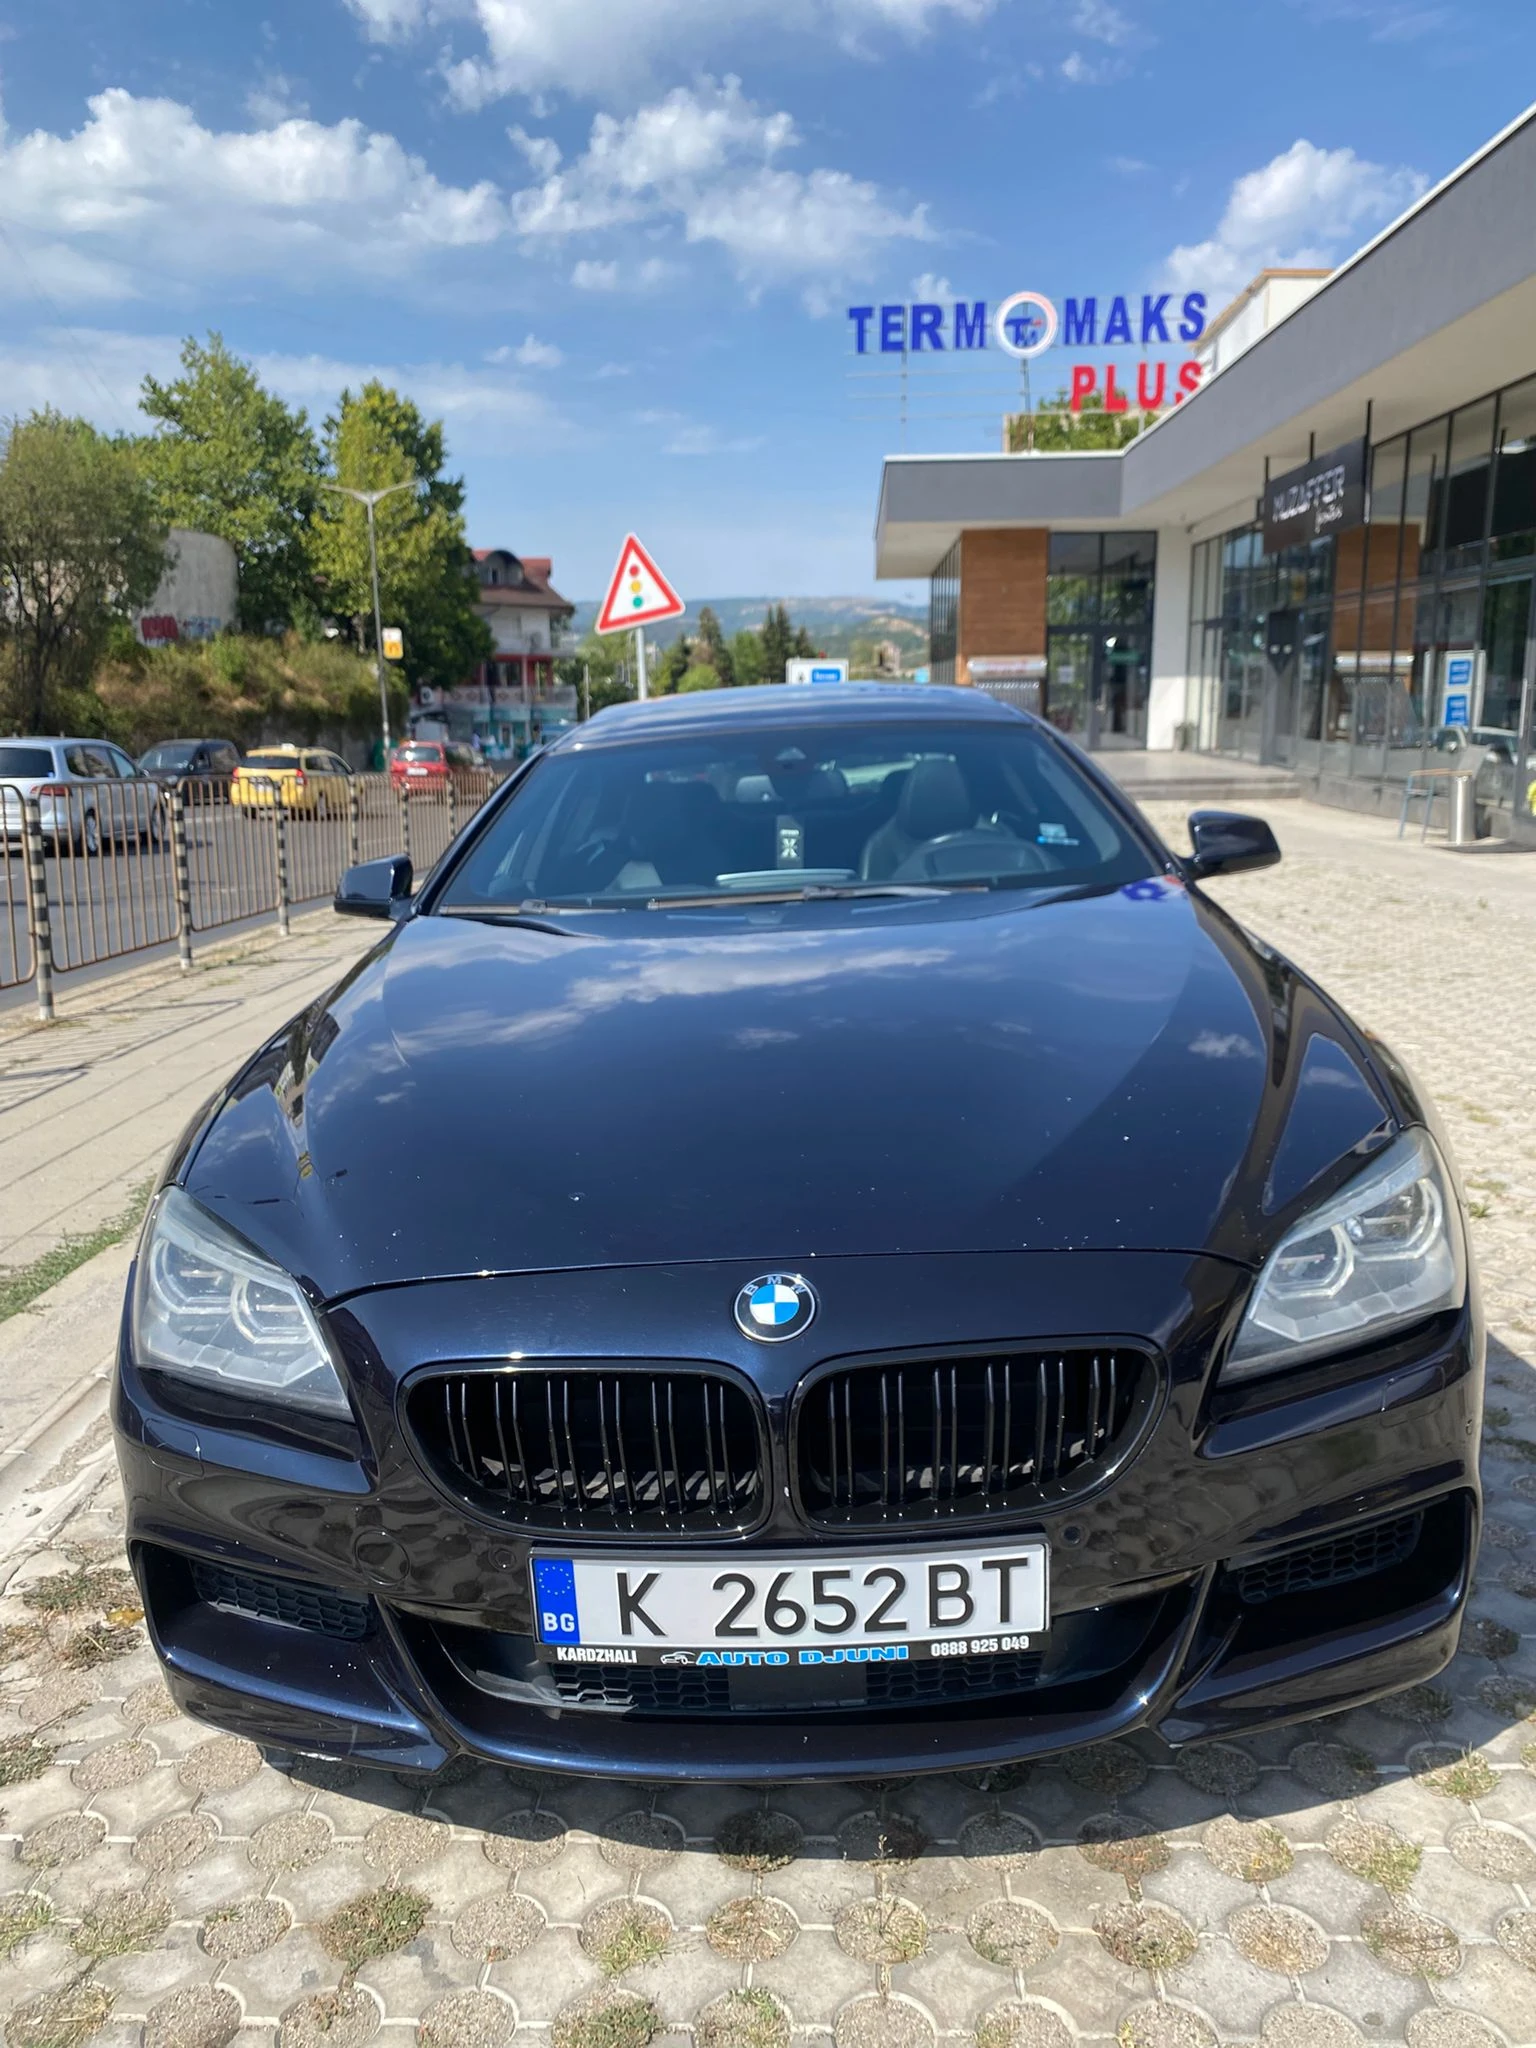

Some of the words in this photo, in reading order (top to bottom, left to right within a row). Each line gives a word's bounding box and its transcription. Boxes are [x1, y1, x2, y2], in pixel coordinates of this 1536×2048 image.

[1071, 361, 1204, 413] PLUS
[743, 1275, 807, 1296] BMW
[616, 1572, 665, 1636] K
[712, 1567, 908, 1637] 2652
[928, 1557, 1029, 1628] BT
[543, 1612, 576, 1633] BG
[556, 1647, 638, 1664] KARDZHALI
[696, 1651, 790, 1666] AUTO
[798, 1645, 909, 1665] DJUNI
[930, 1640, 968, 1657] 0888
[971, 1637, 998, 1654] 925
[1001, 1635, 1030, 1651] 049
